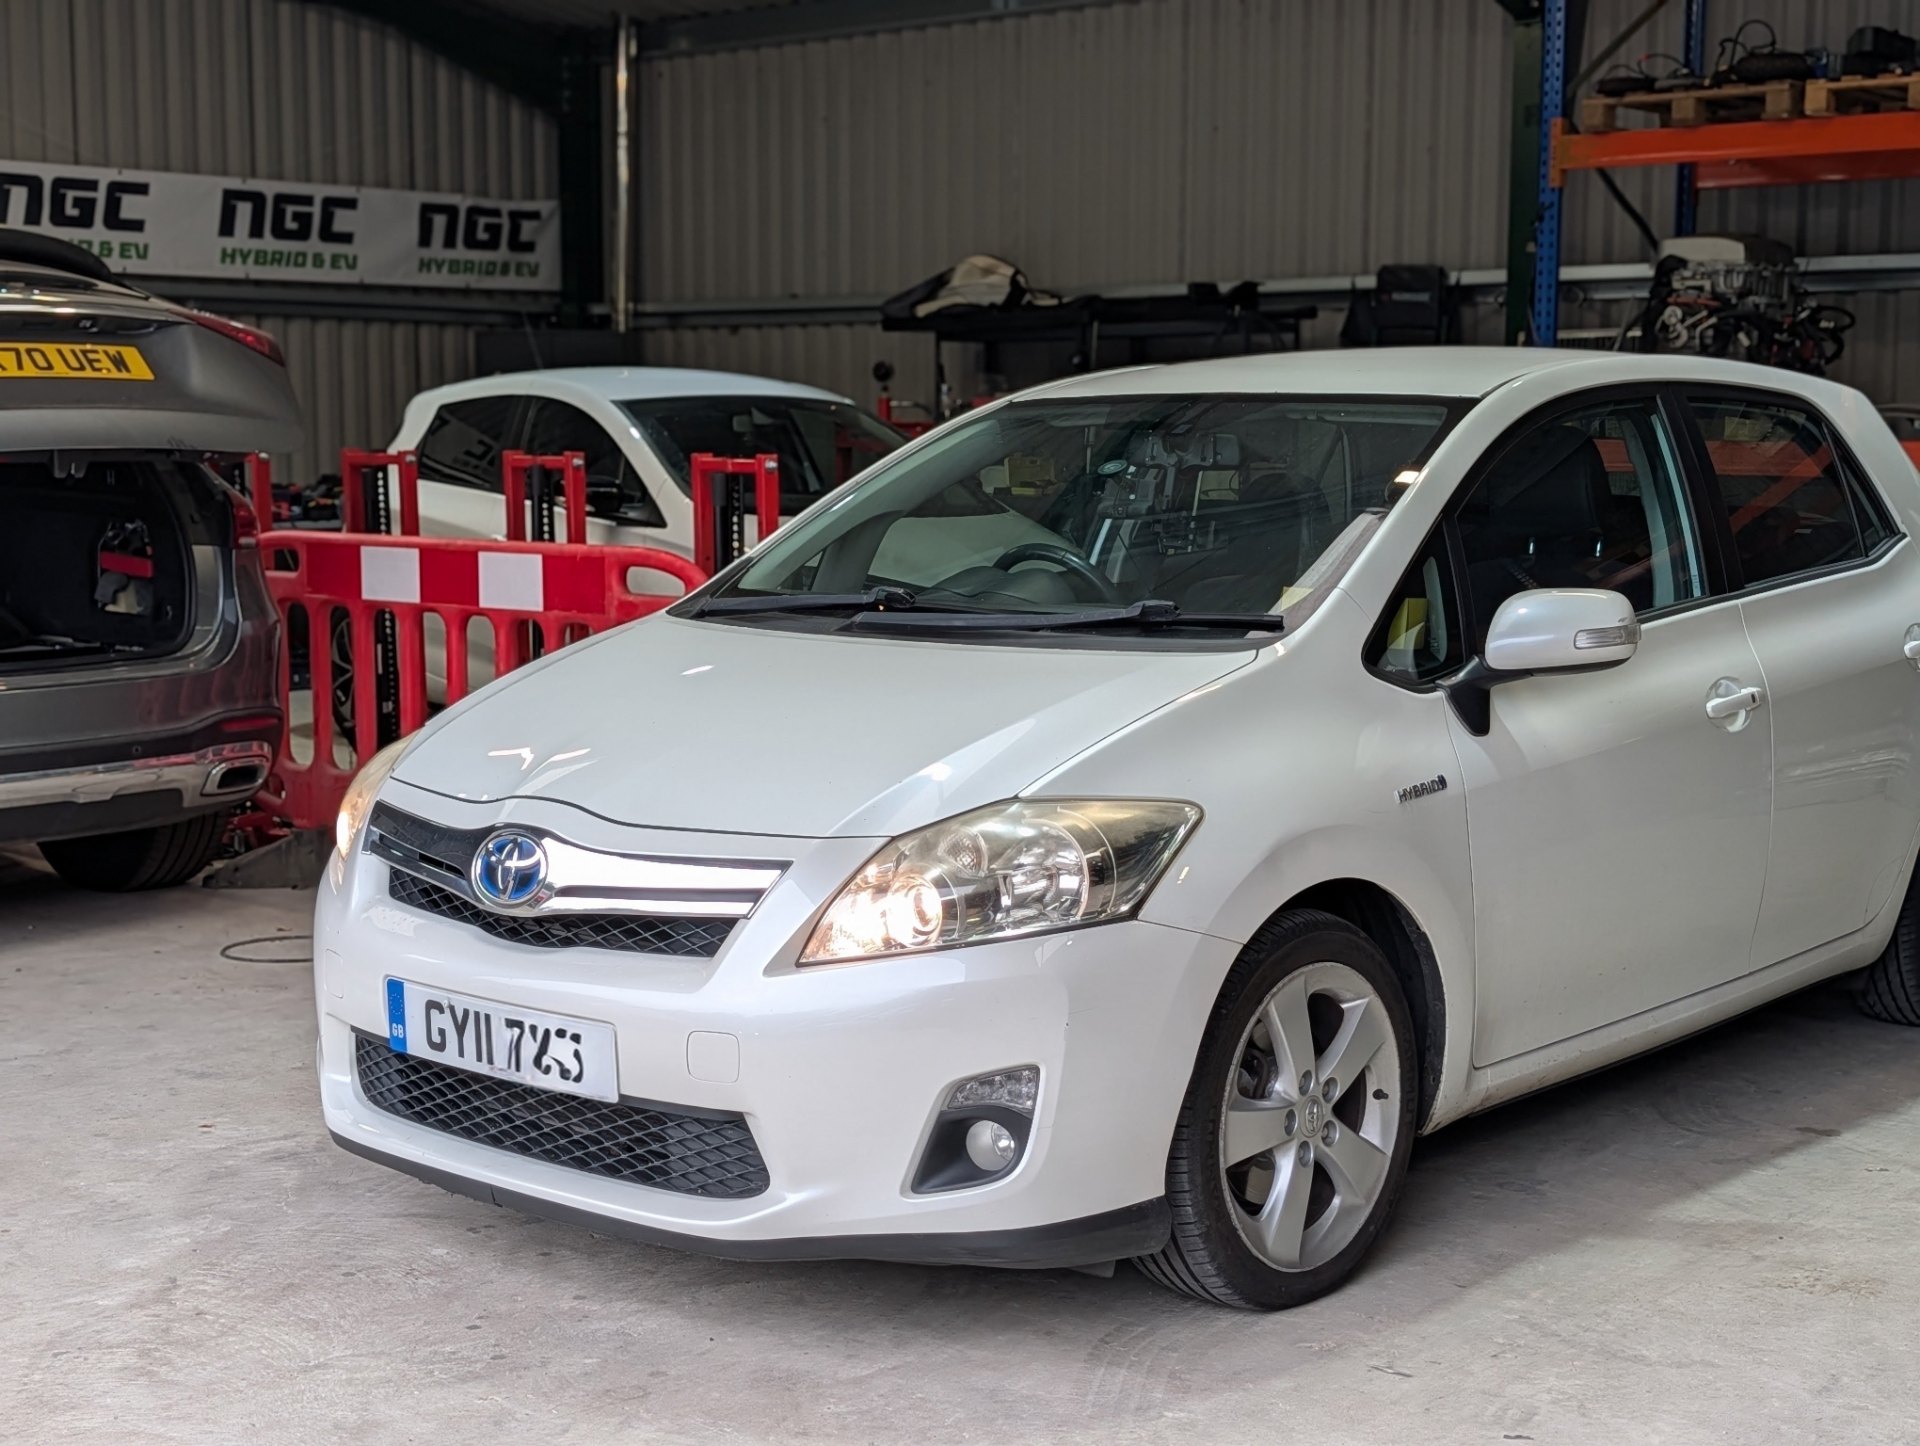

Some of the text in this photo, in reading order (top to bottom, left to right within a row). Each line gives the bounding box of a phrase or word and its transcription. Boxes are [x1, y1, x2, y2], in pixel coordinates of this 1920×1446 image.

[0, 172, 149, 233] NGC
[218, 188, 358, 245] NGC
[419, 203, 541, 253] NGC
[119, 243, 149, 260] EV
[221, 247, 358, 270] HYBRID & EV
[419, 257, 497, 277] HYBRID
[514, 261, 539, 277] EV
[56, 348, 131, 373] UEW
[1394, 779, 1440, 804] HYBRID
[392, 1022, 404, 1039] GB
